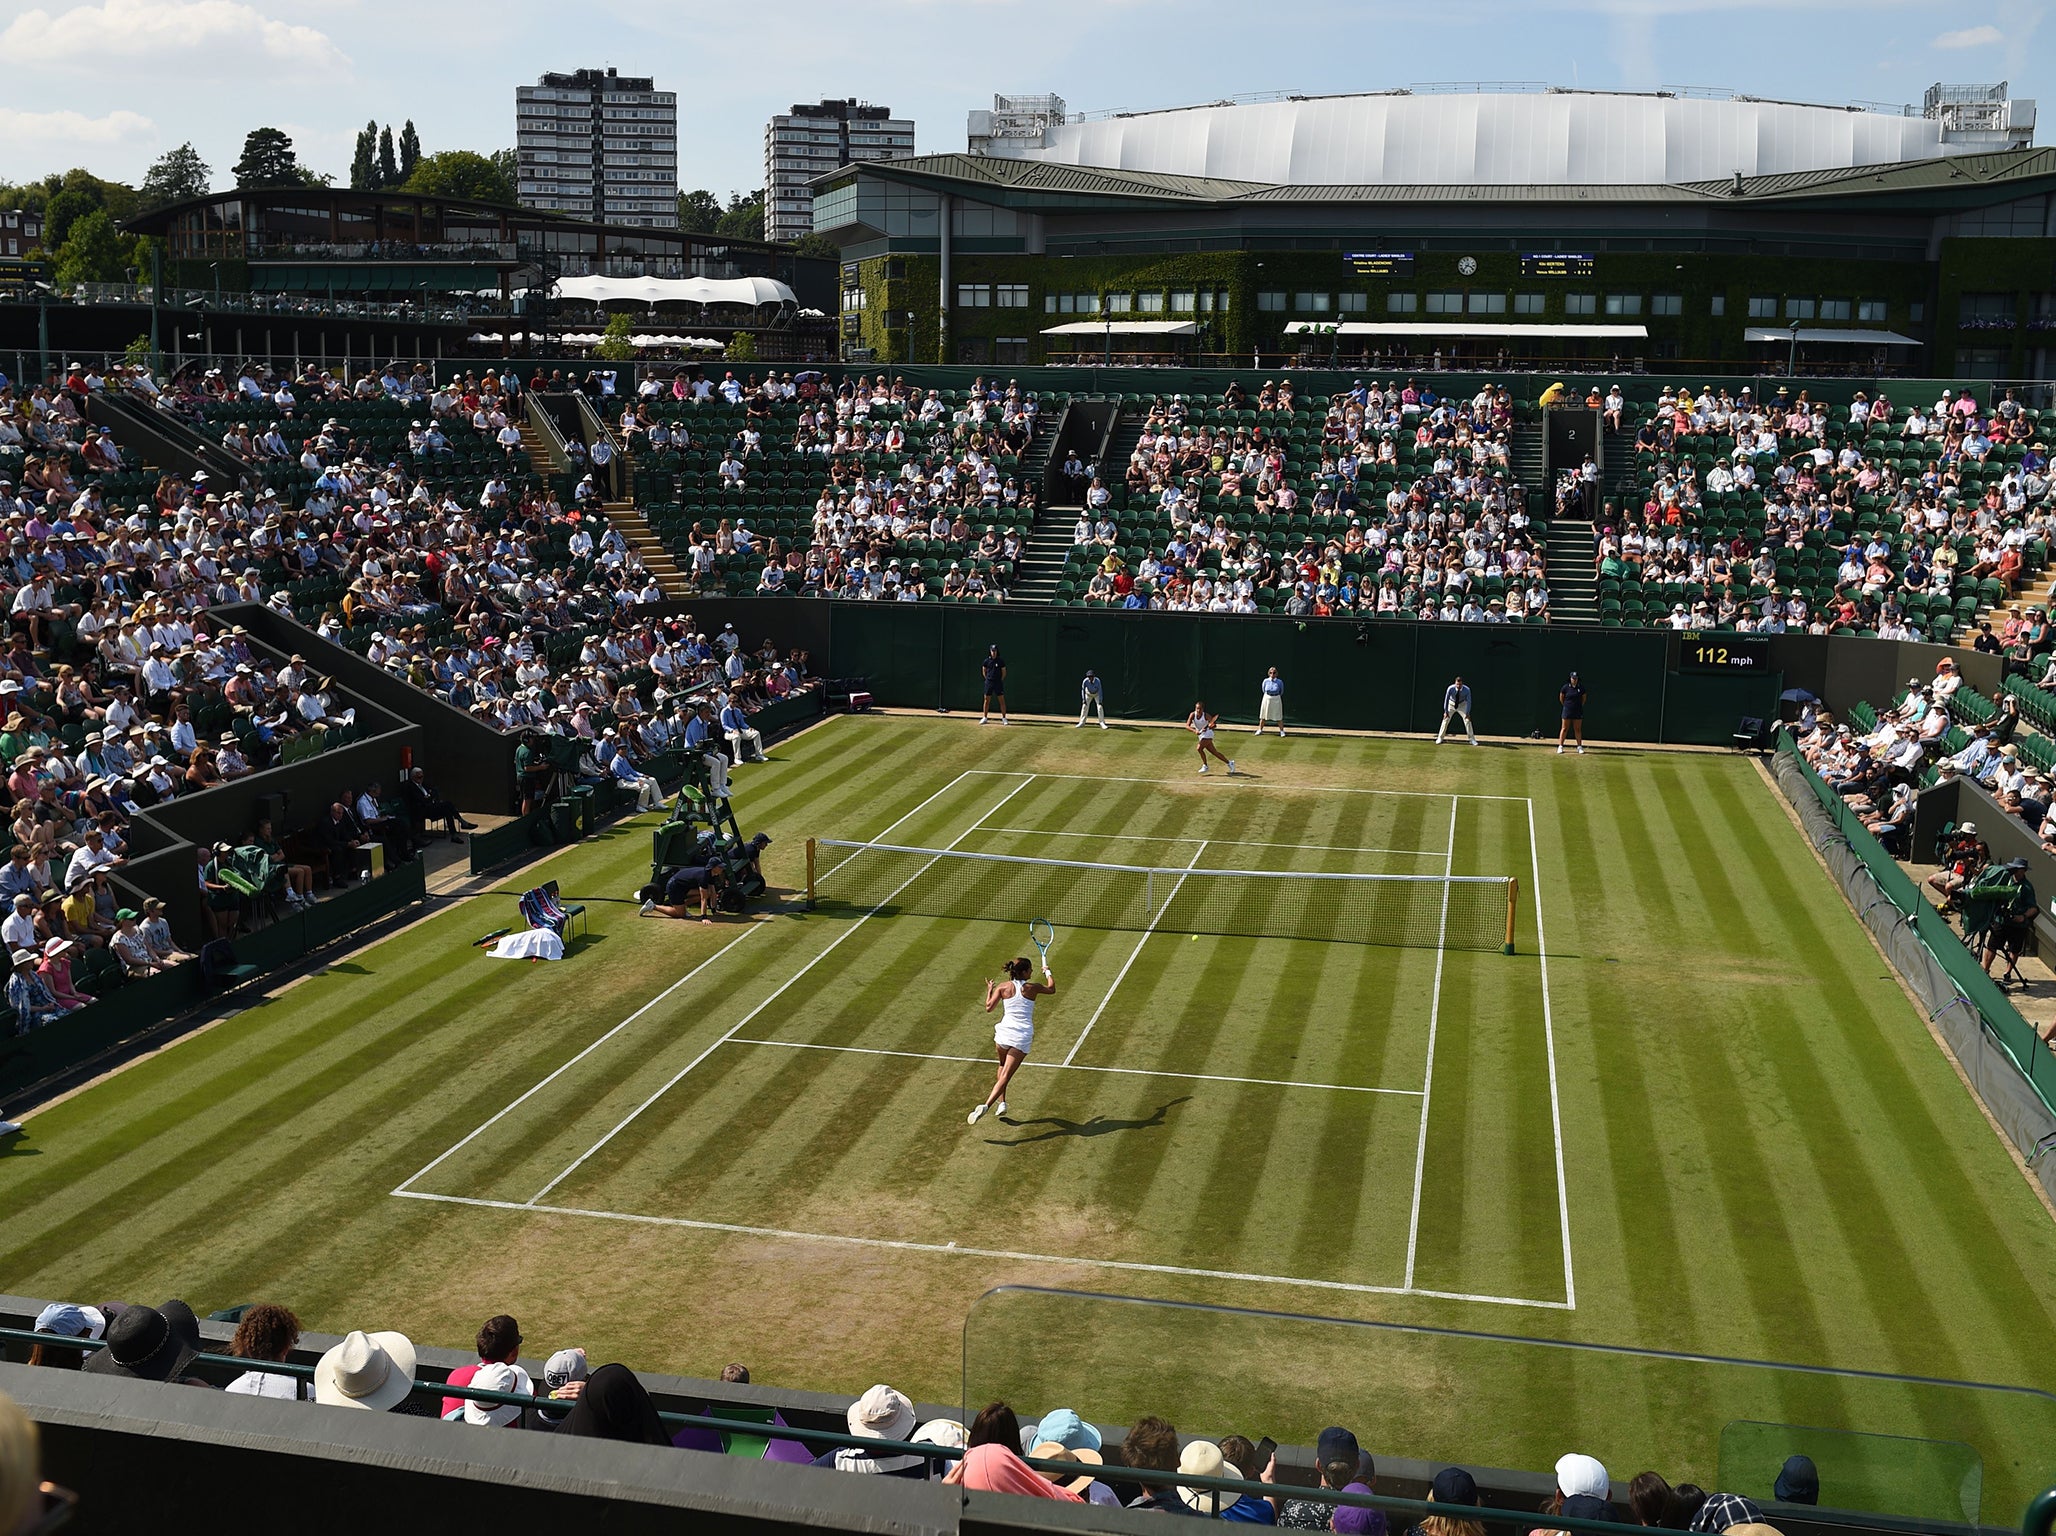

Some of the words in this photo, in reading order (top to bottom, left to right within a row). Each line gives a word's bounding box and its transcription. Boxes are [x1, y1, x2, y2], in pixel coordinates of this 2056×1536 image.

[1091, 420, 1096, 431] 1
[1568, 429, 1576, 440] 2
[1682, 632, 1700, 640] IBM
[1695, 647, 1728, 664] 112
[1730, 656, 1753, 667] mph
[548, 1373, 567, 1385] OBEY
